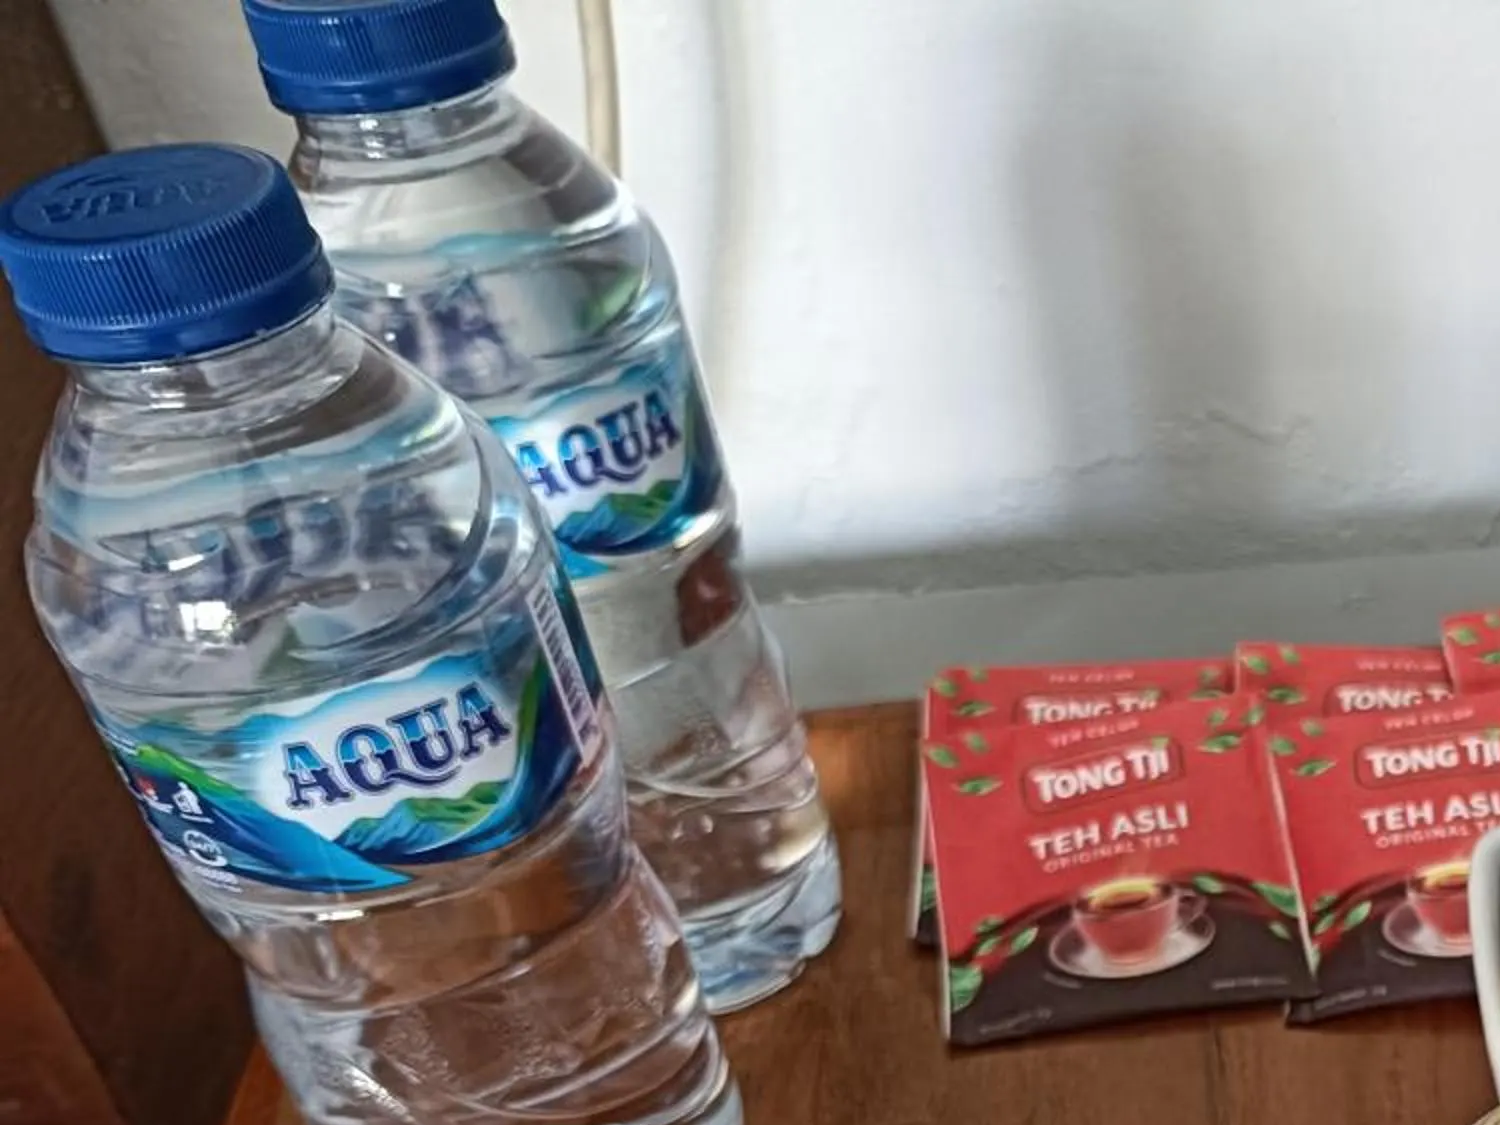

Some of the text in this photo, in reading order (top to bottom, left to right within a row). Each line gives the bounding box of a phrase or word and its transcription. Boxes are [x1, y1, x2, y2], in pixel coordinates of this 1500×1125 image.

[516, 391, 682, 498] AQUA
[281, 681, 512, 811] AQUA
[1364, 742, 1462, 779] TONG
[1029, 755, 1127, 804] TONG
[1028, 800, 1189, 860] TEH ASLI
[1360, 800, 1435, 835] TEH
